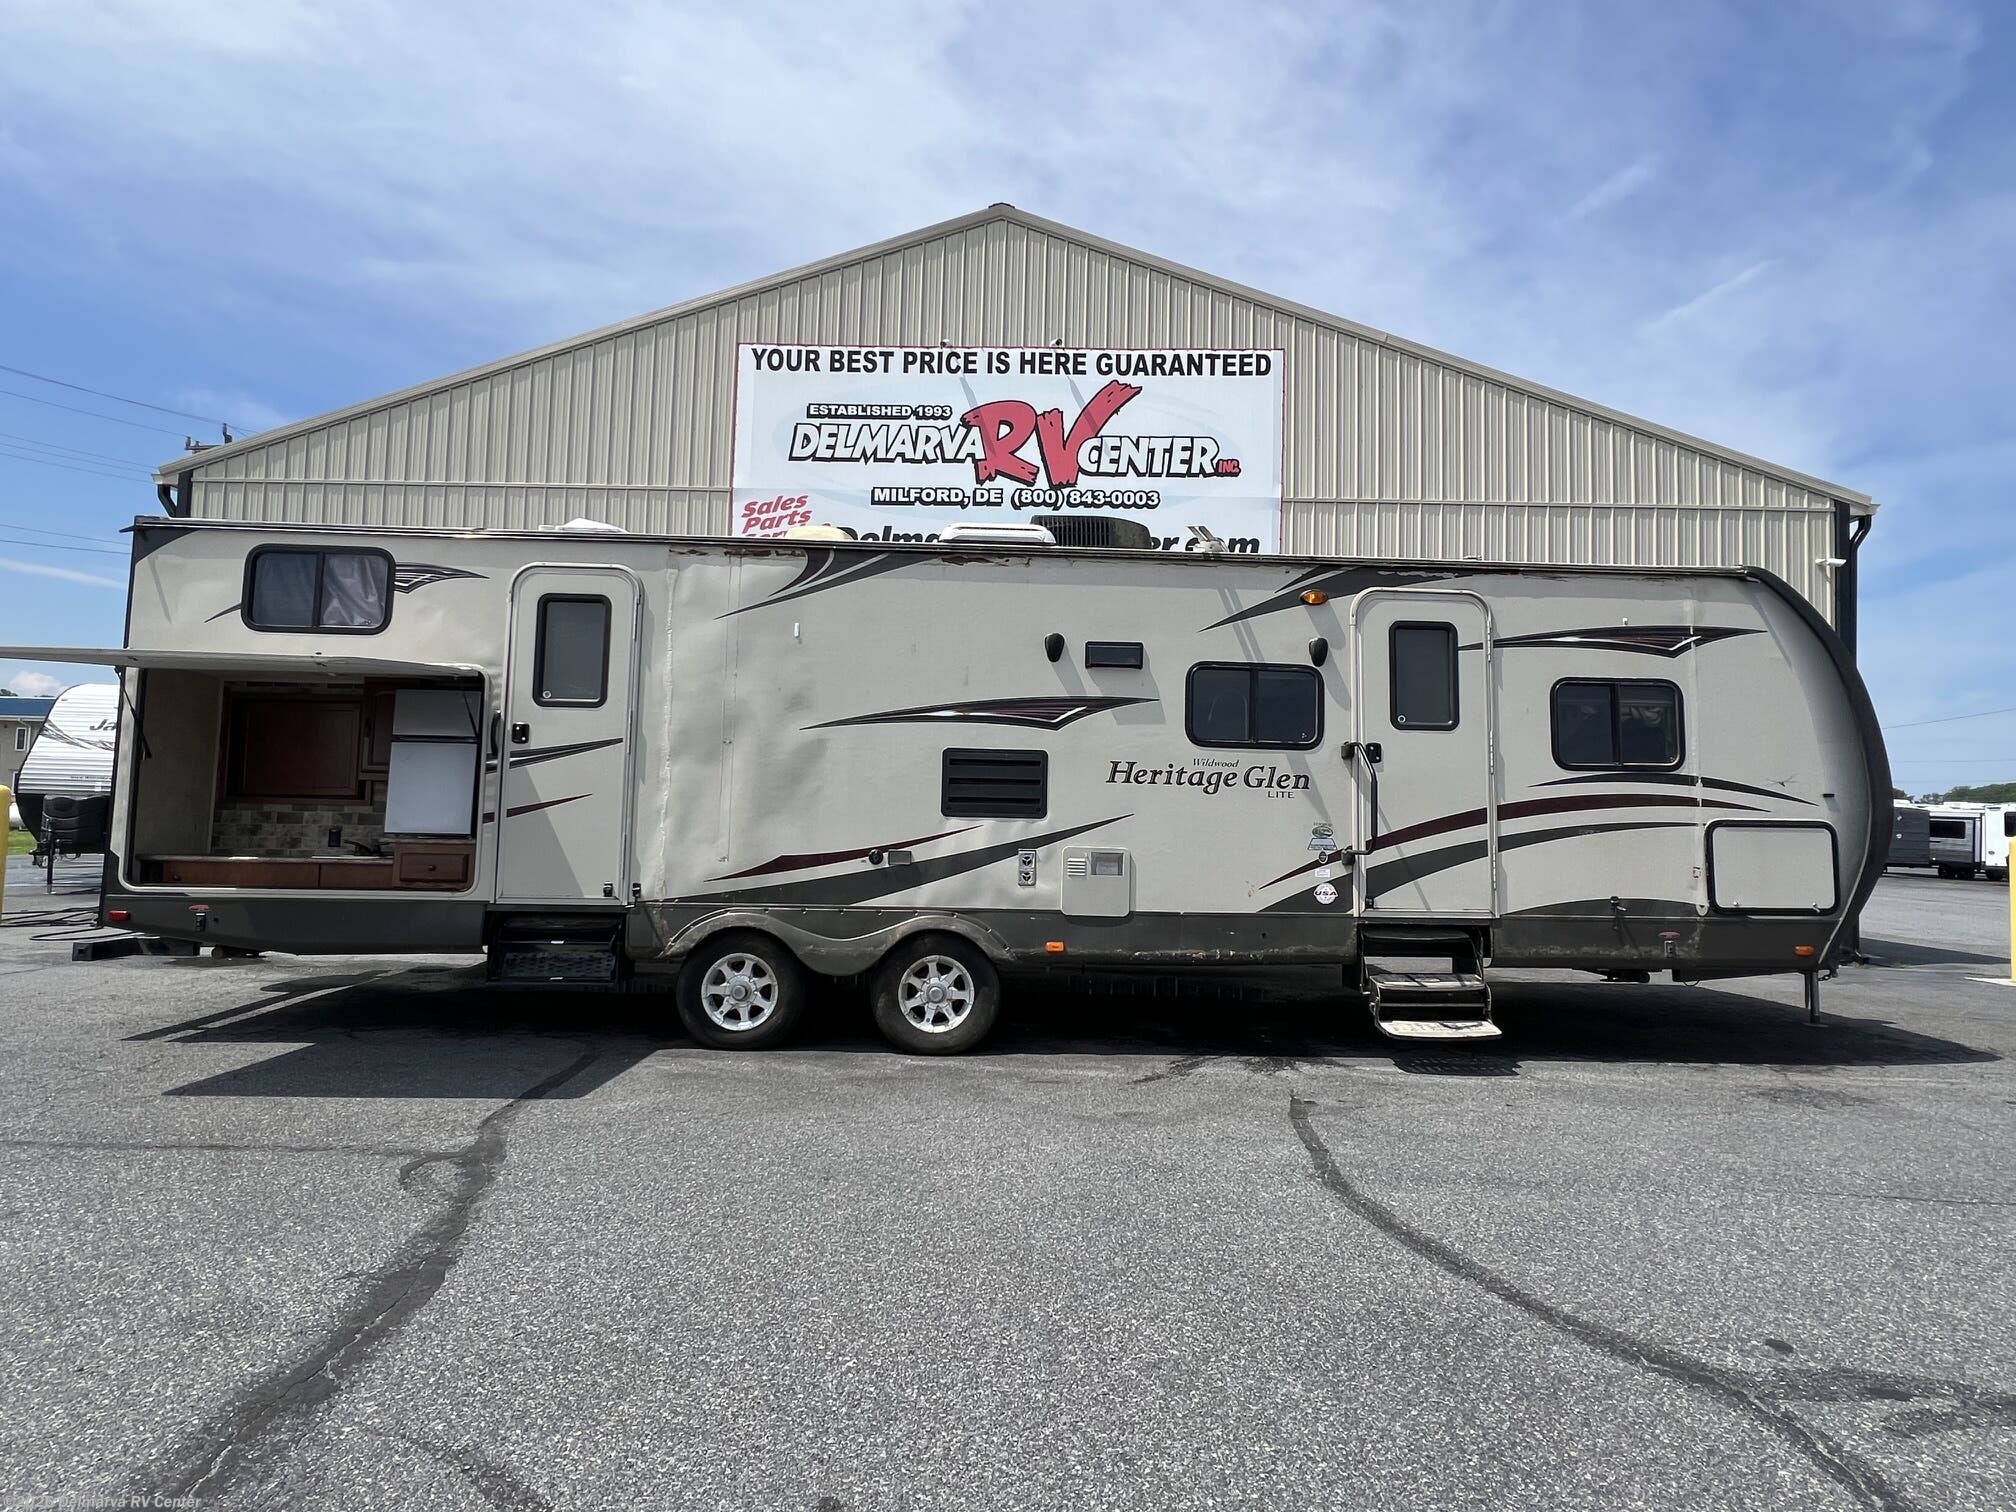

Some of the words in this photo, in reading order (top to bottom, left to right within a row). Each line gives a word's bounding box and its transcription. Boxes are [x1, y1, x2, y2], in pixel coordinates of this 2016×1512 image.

[751, 348, 821, 372] YOUR
[829, 350, 895, 374] BEST
[902, 351, 978, 375] PRICE
[986, 351, 1012, 375] IS
[1019, 351, 1087, 376] HERE
[1095, 353, 1272, 377] GUARANTEED
[807, 403, 912, 420] ESTABLISHED
[914, 404, 953, 419] 1993
[788, 422, 986, 465] DELMARVA
[960, 379, 1143, 488] RV
[1076, 436, 1220, 478] CENTER
[741, 495, 809, 518] Sales
[871, 487, 970, 510] MILFORD,
[972, 488, 1003, 507] DE
[1011, 488, 1066, 511] (800)
[1067, 489, 1160, 510] 843-0003
[741, 509, 812, 534] Parts
[1192, 758, 1240, 768] Wildwood
[1105, 760, 1238, 794] Heritage
[1243, 765, 1311, 790] Glen
[1267, 790, 1295, 798] LITE
